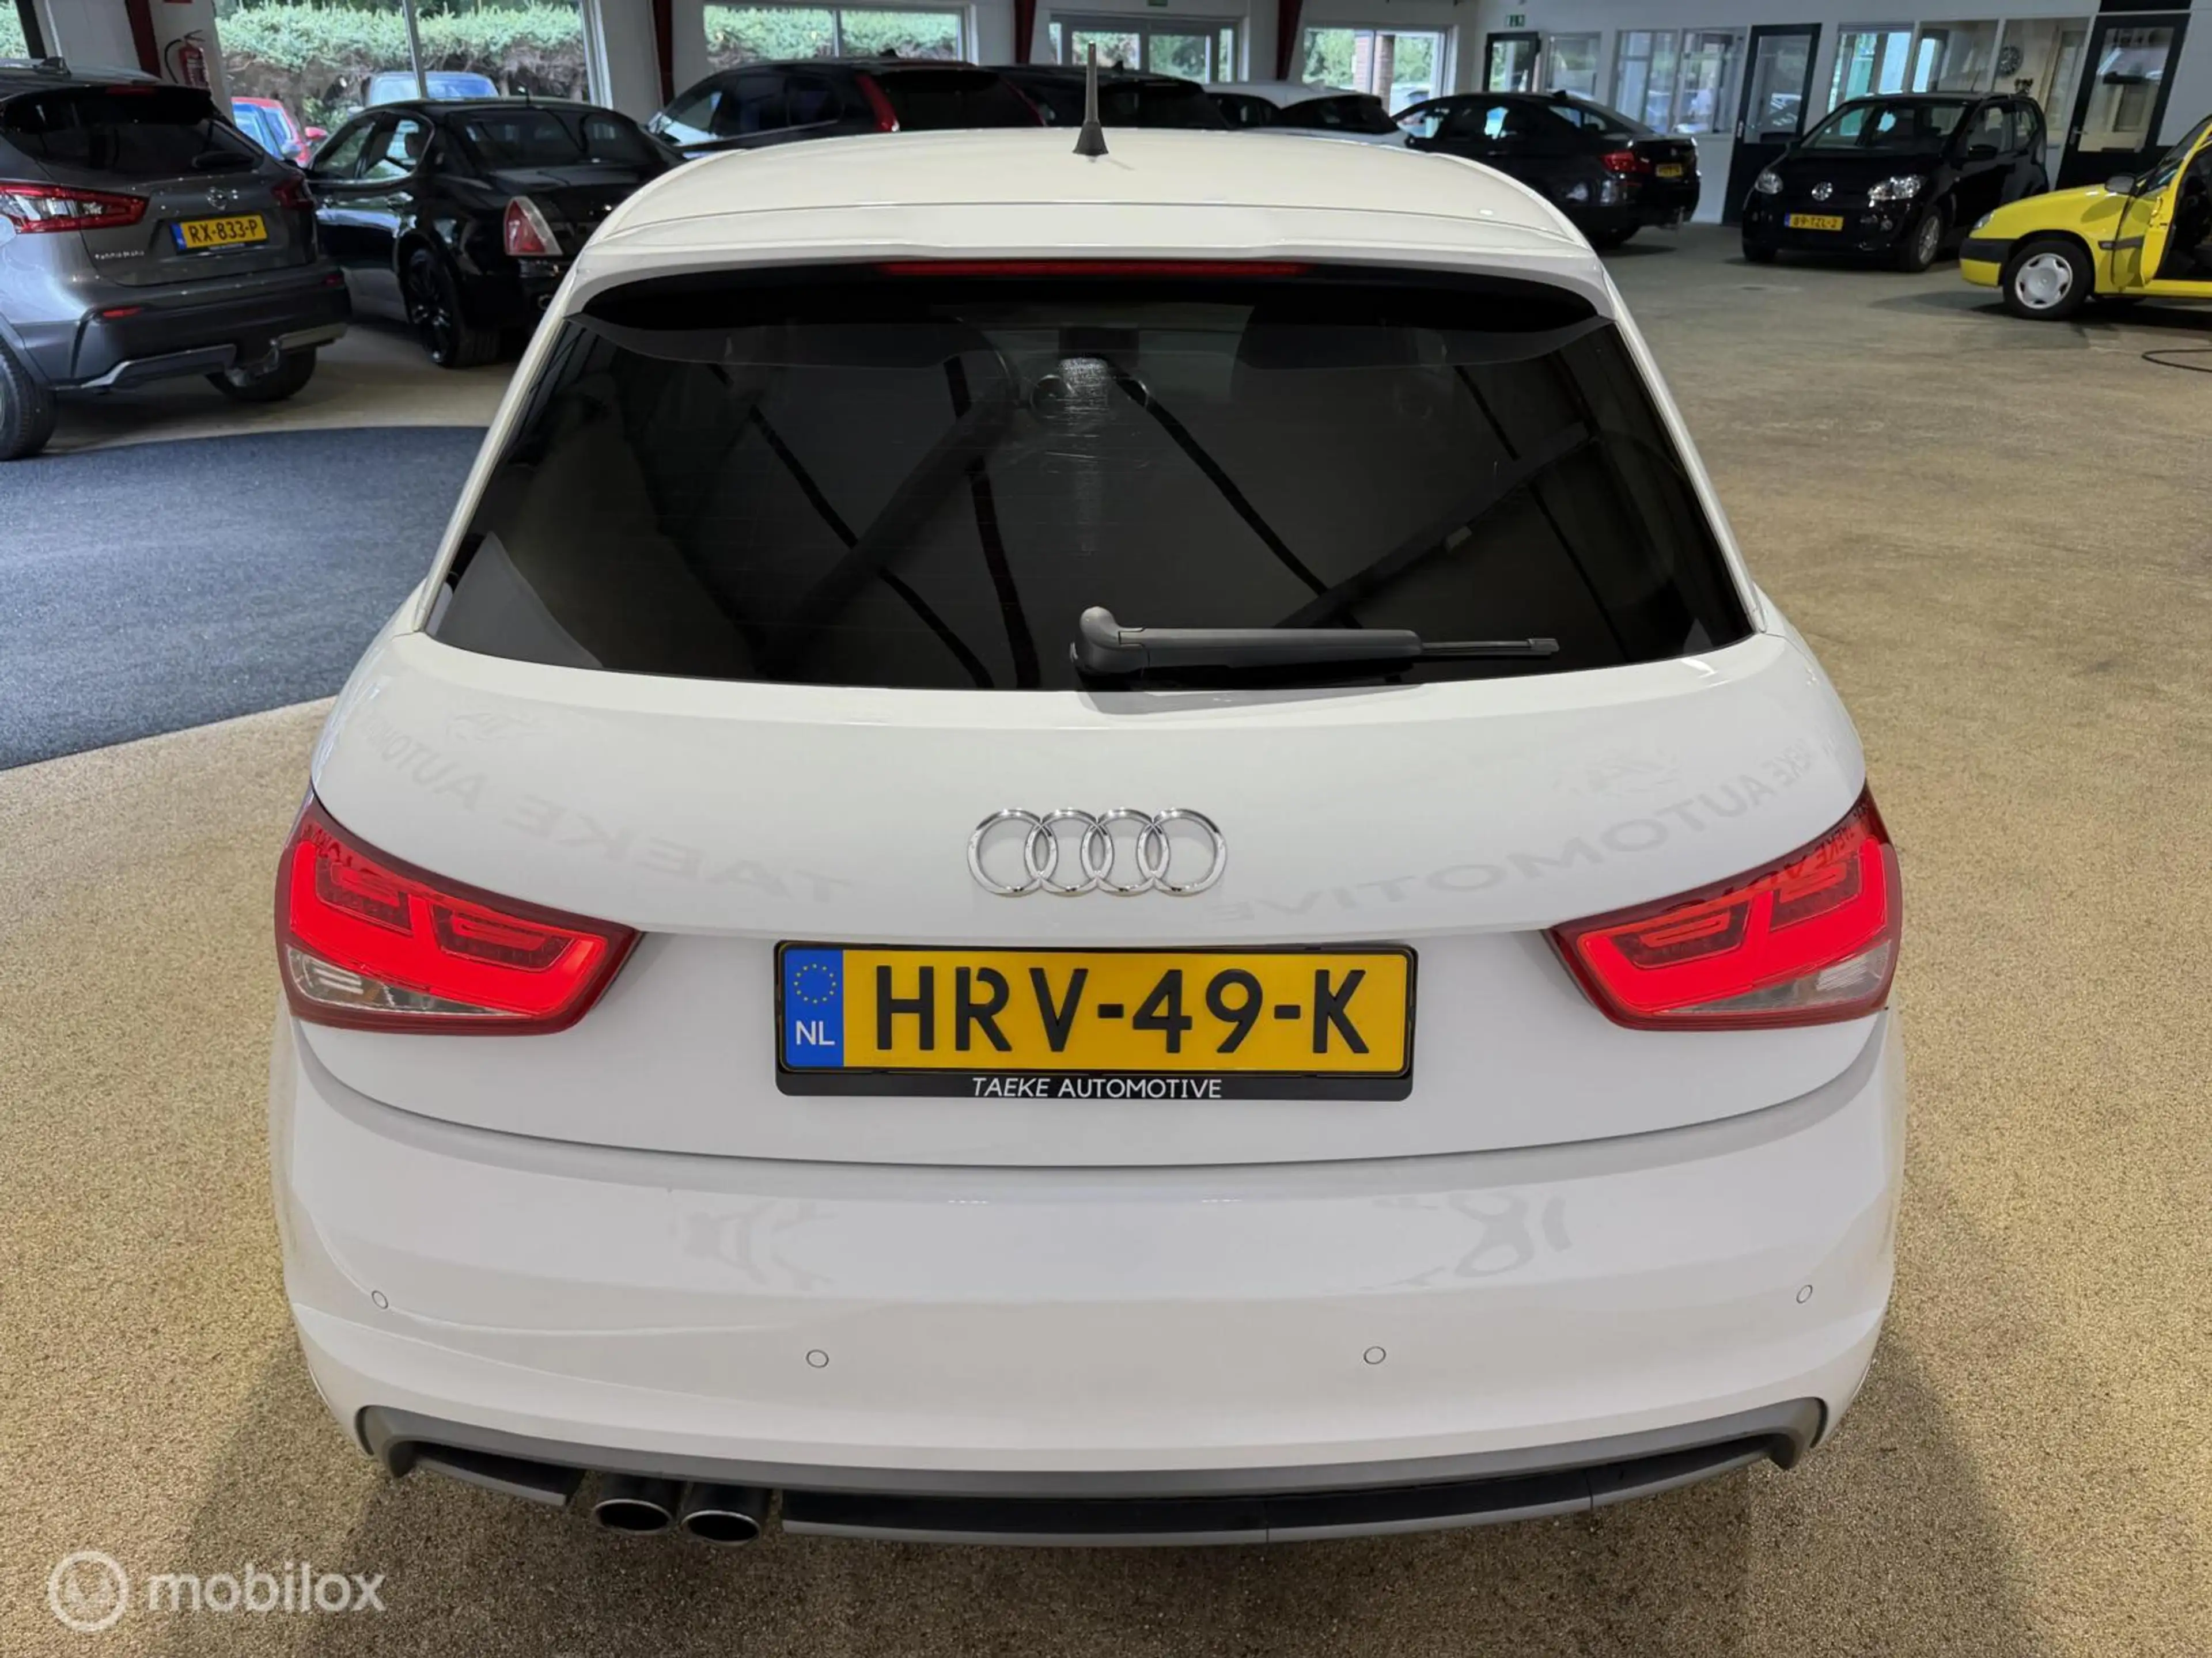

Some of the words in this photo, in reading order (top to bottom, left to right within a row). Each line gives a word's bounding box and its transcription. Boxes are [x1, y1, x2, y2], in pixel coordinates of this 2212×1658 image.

[187, 219, 258, 243] RX-833-P
[876, 965, 1369, 1054] HRV-49-K
[796, 1020, 835, 1046] NL
[972, 1077, 1051, 1097] TAEKE
[1058, 1078, 1222, 1098] AUTOMOTIVE
